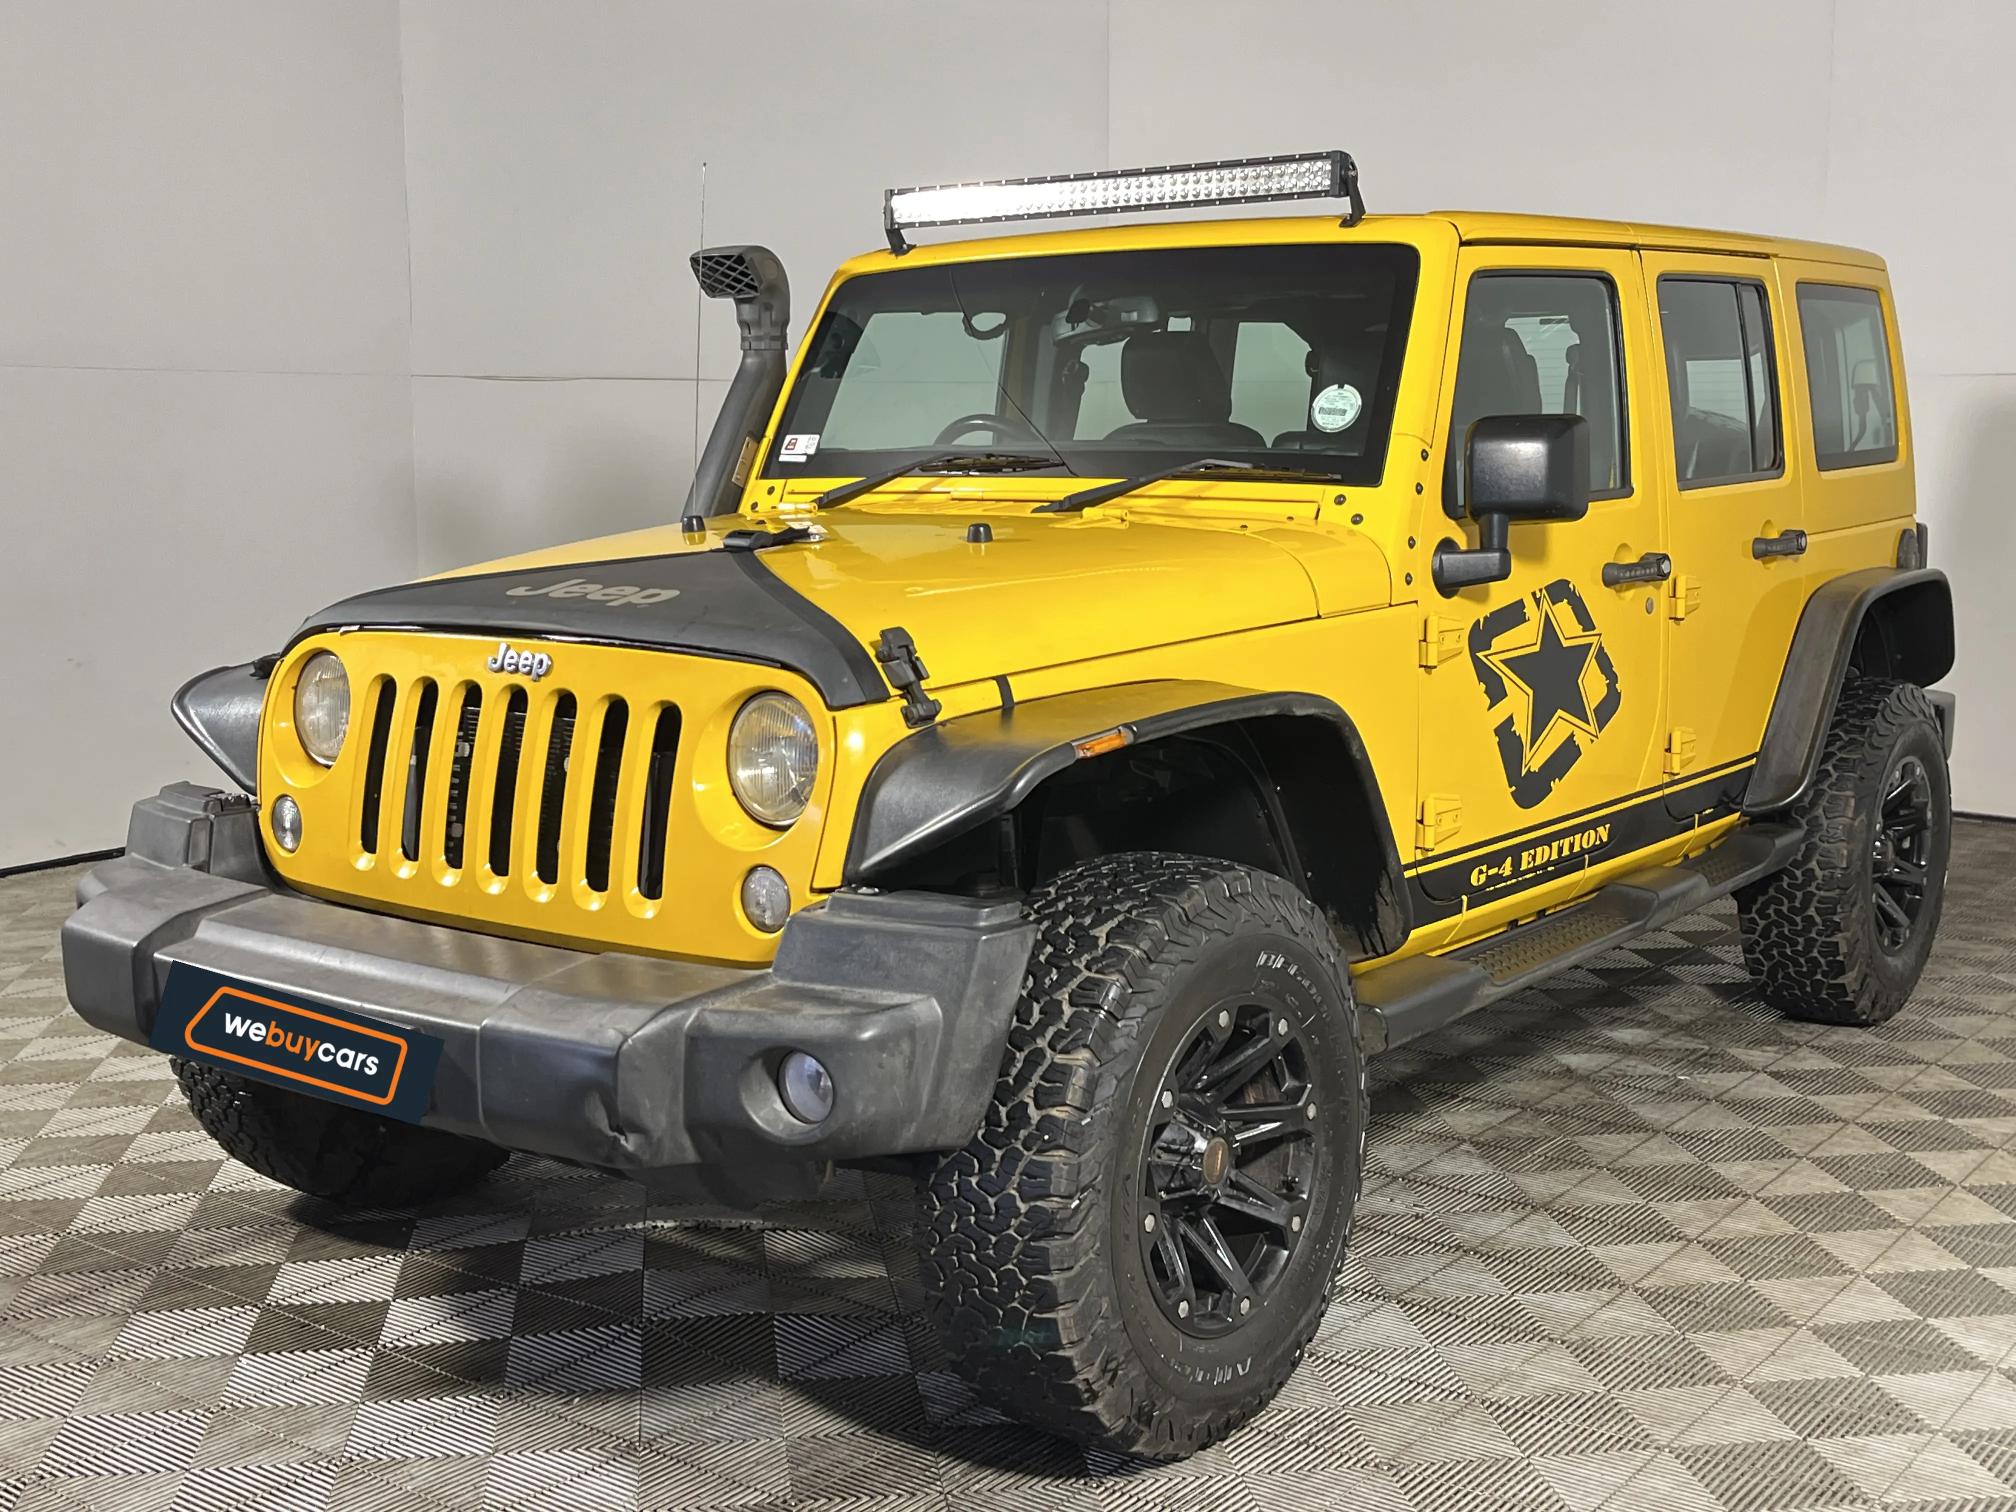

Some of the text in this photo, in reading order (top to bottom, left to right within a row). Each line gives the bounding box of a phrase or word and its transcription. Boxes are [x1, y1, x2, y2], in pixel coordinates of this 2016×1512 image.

[506, 578, 681, 607] Jeep
[487, 642, 553, 681] Jeep
[1470, 856, 1512, 886] G-4
[1520, 824, 1610, 871] EDITION
